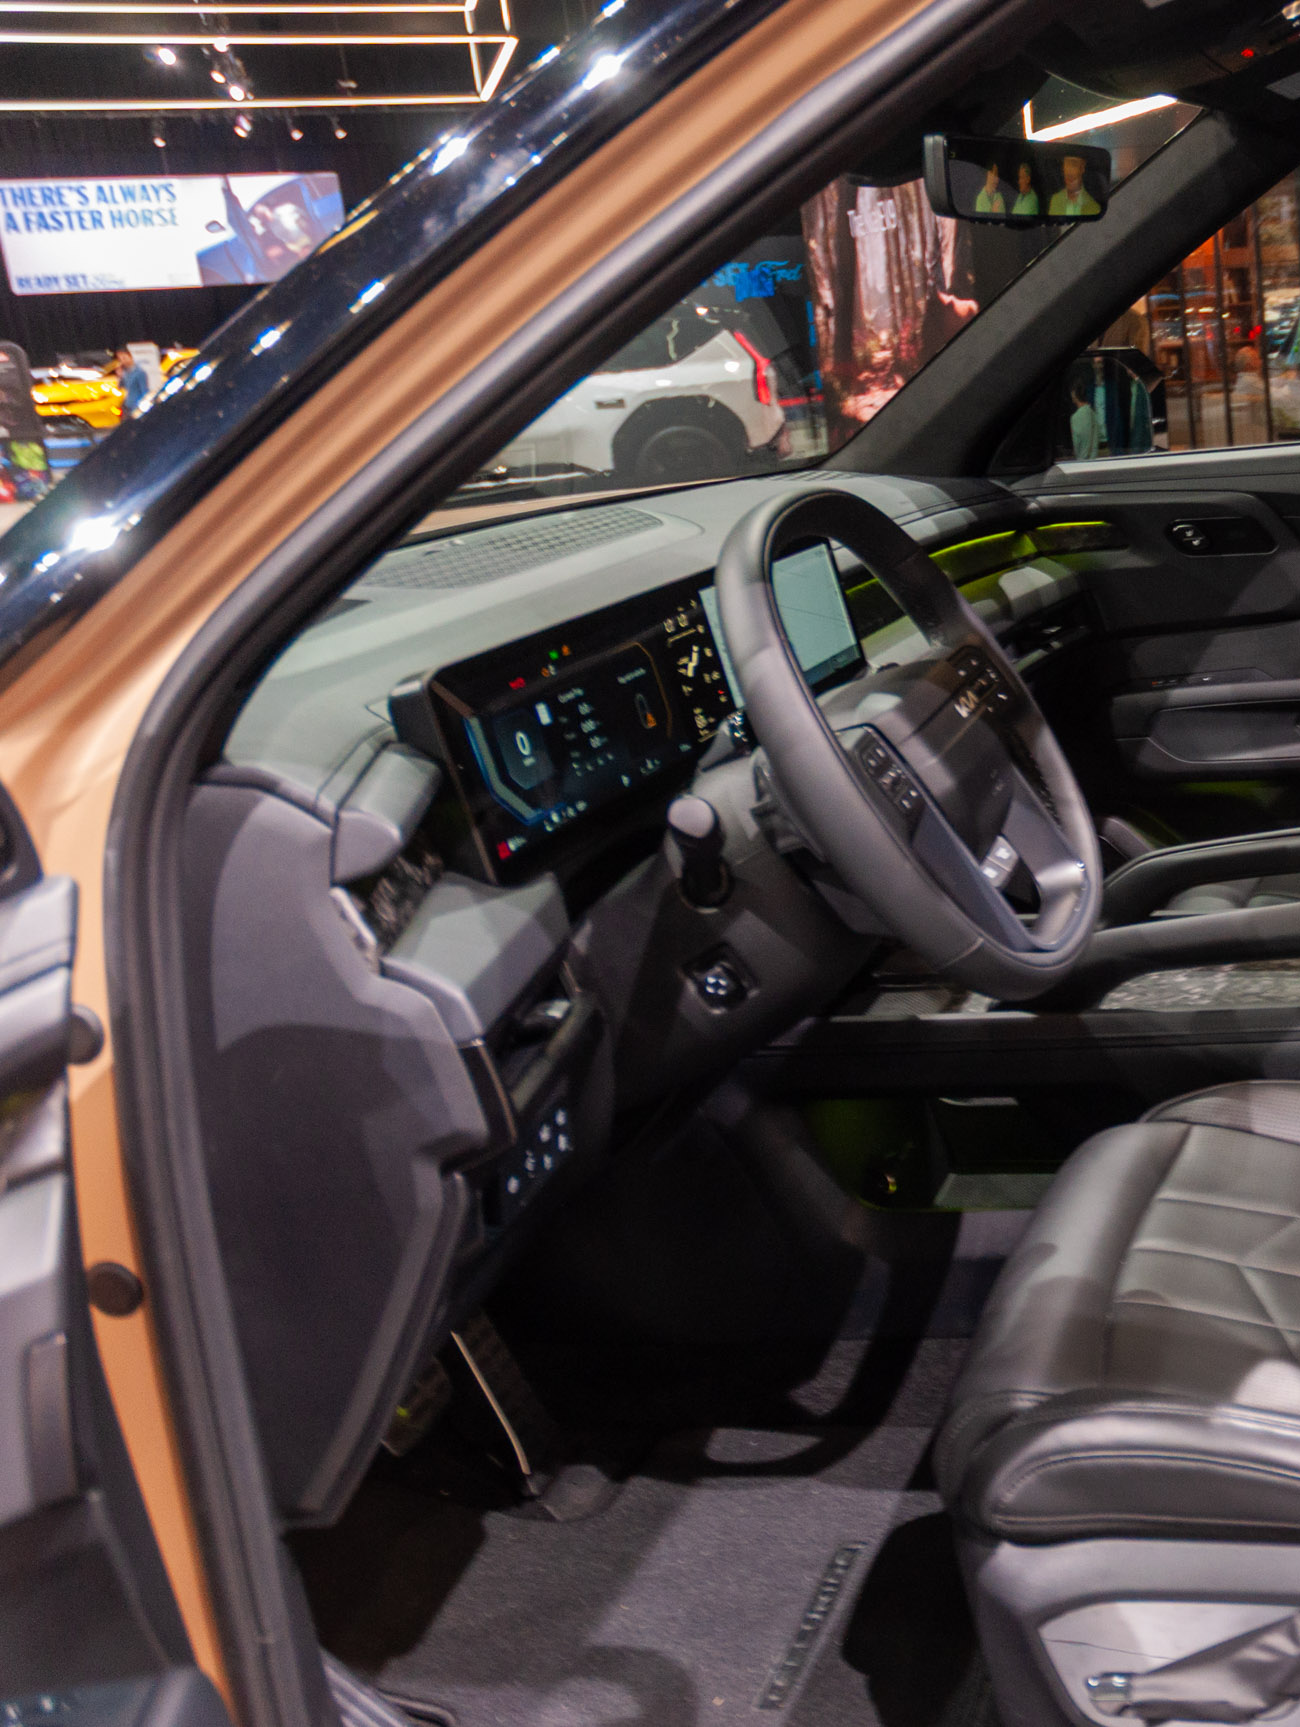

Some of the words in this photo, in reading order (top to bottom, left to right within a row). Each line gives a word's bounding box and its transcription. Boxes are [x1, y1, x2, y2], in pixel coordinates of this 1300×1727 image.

[0, 185, 89, 207] THERE'S
[96, 183, 177, 204] ALWAYS
[5, 212, 20, 233] A
[23, 210, 104, 232] FASTER
[109, 208, 179, 229] HORSE
